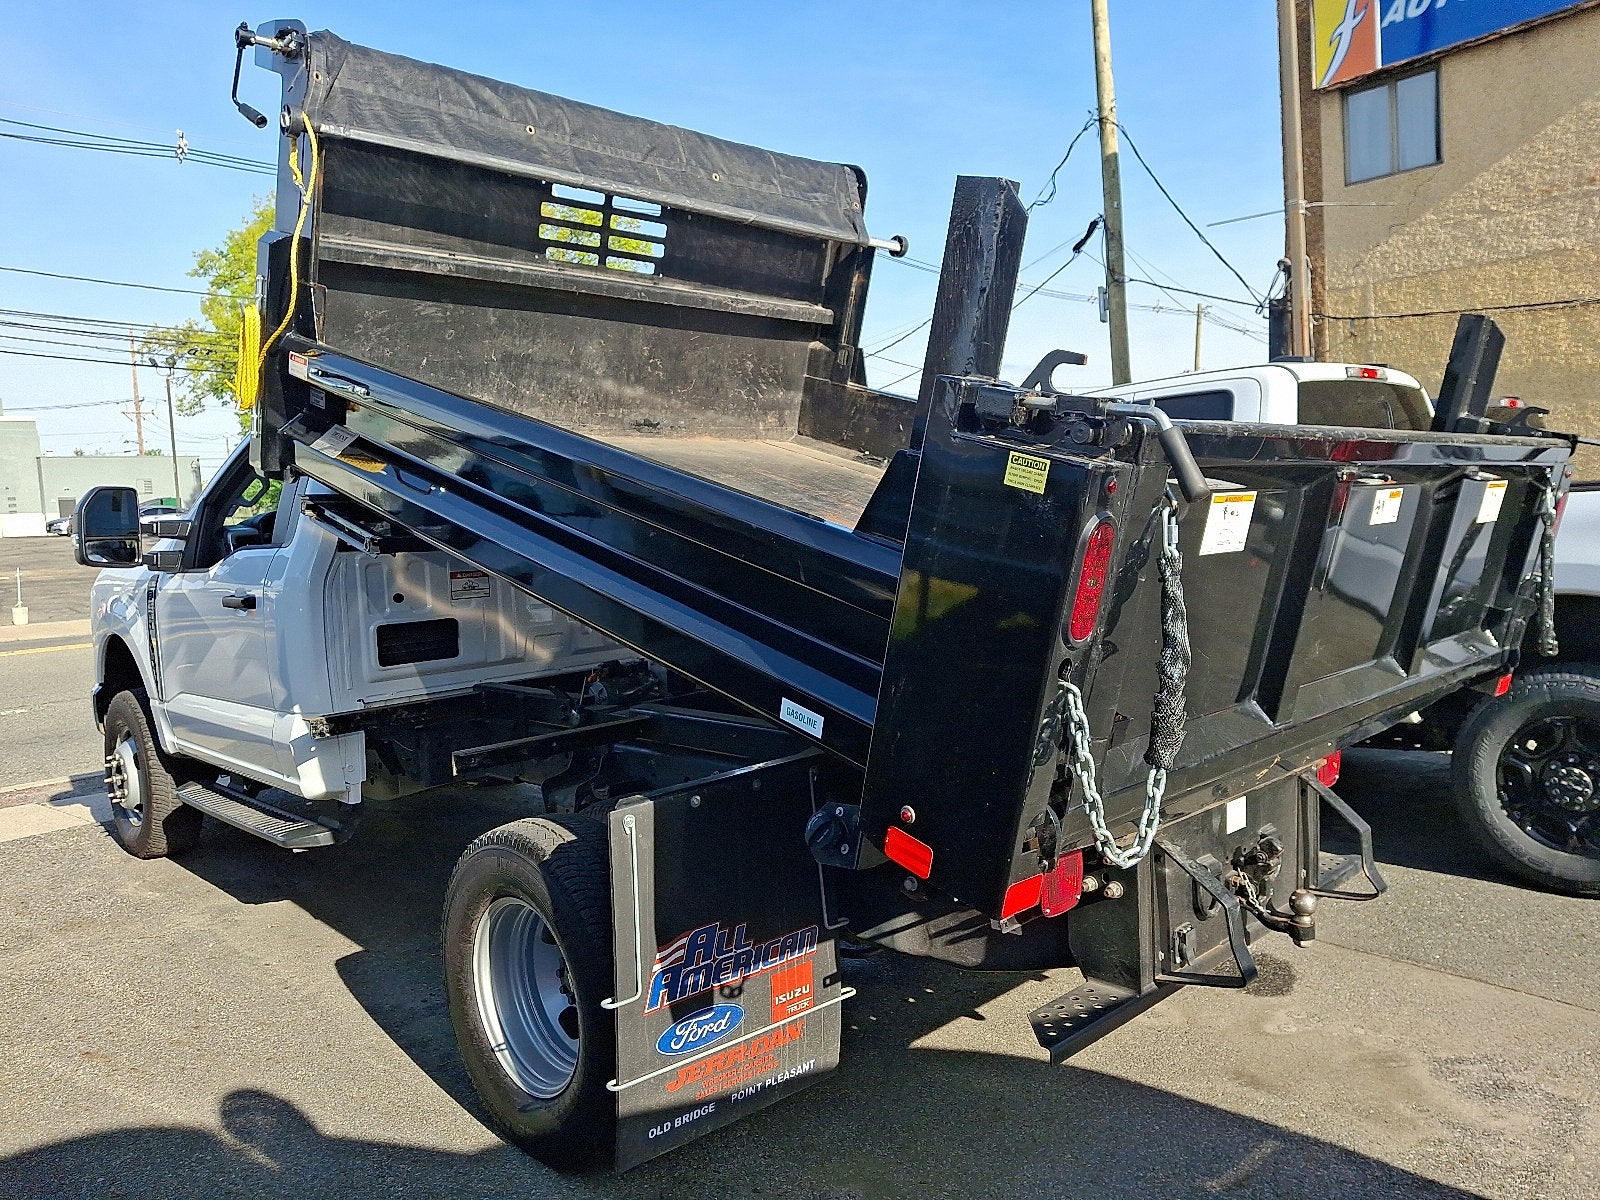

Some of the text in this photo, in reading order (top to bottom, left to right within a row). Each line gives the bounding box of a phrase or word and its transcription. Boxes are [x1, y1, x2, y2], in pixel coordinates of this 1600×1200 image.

[1012, 455, 1046, 471] CAUTION
[786, 706, 818, 730] GASOLINE
[683, 922, 752, 967] ALL
[644, 925, 818, 1015] AMERICAN
[775, 984, 810, 1006] ISUZU
[786, 1000, 810, 1014] TRUCK
[670, 1013, 731, 1050] Ford
[665, 1020, 804, 1092] JERR-DAN
[648, 1059, 816, 1139] OLD BRIDGE POINT PLEASANT
